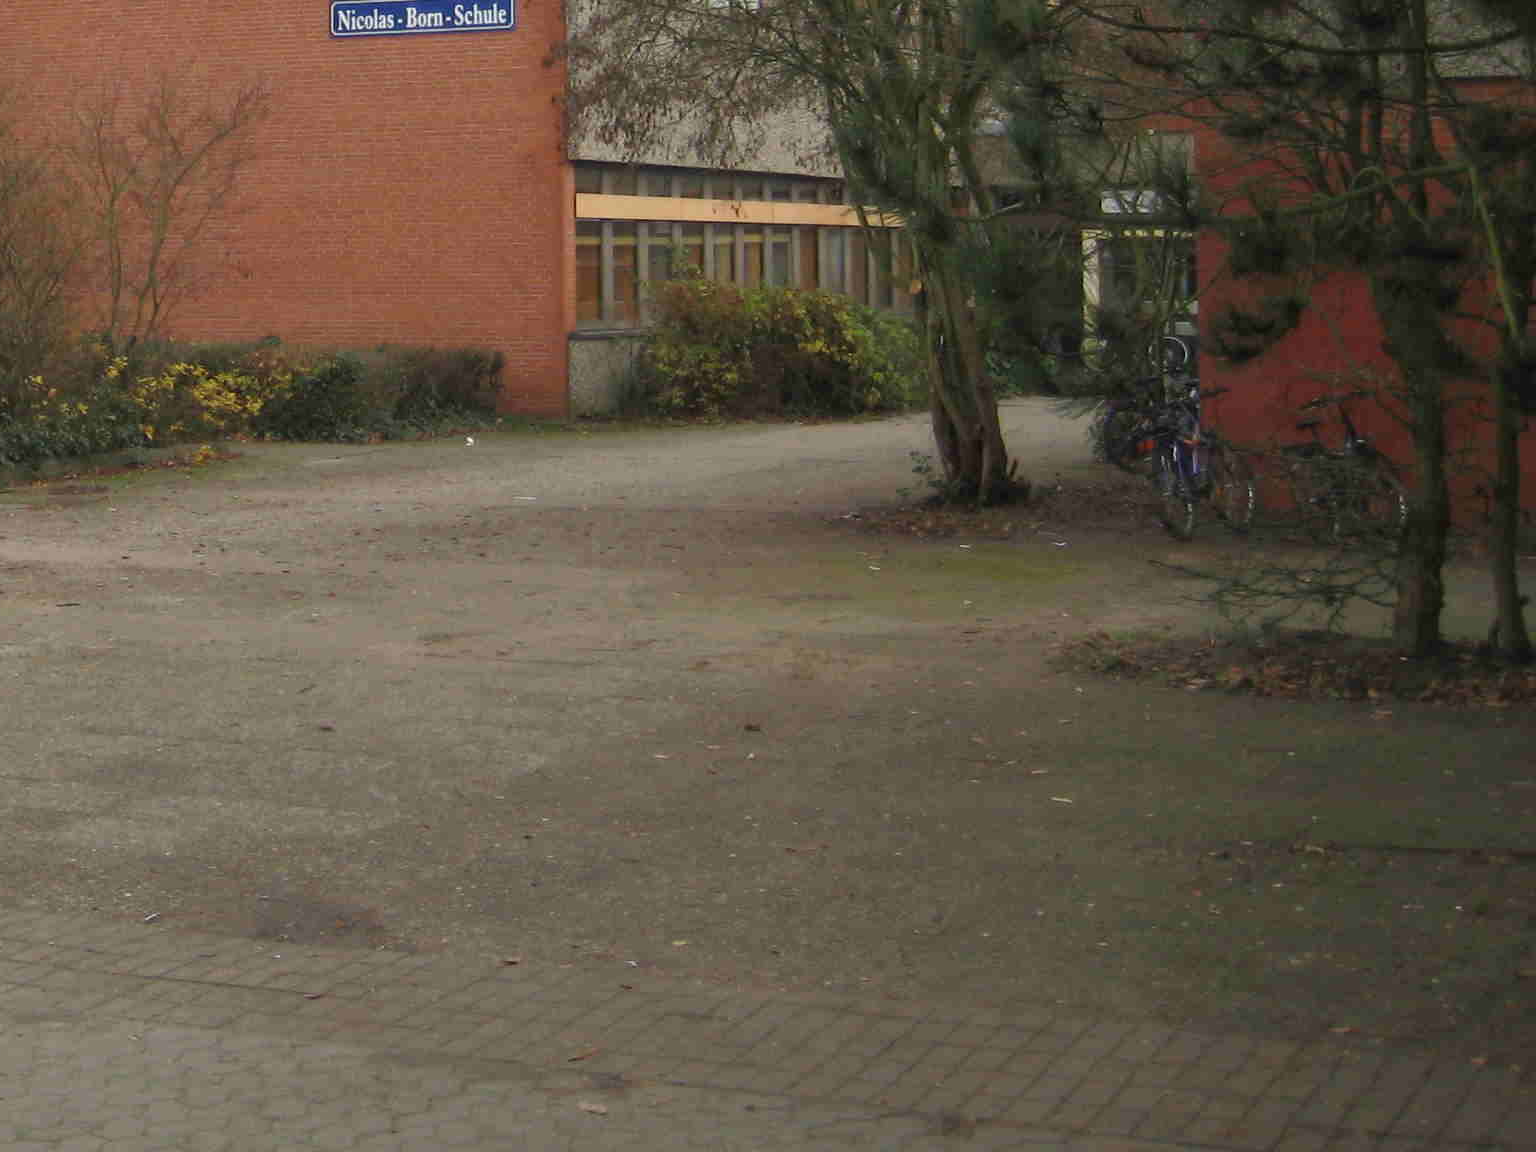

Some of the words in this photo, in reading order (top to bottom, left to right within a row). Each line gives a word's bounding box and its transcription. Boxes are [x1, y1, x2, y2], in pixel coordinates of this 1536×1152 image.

[337, 8, 395, 31] Nicolas
[406, 7, 444, 28] Born
[454, 3, 507, 26] Schule
